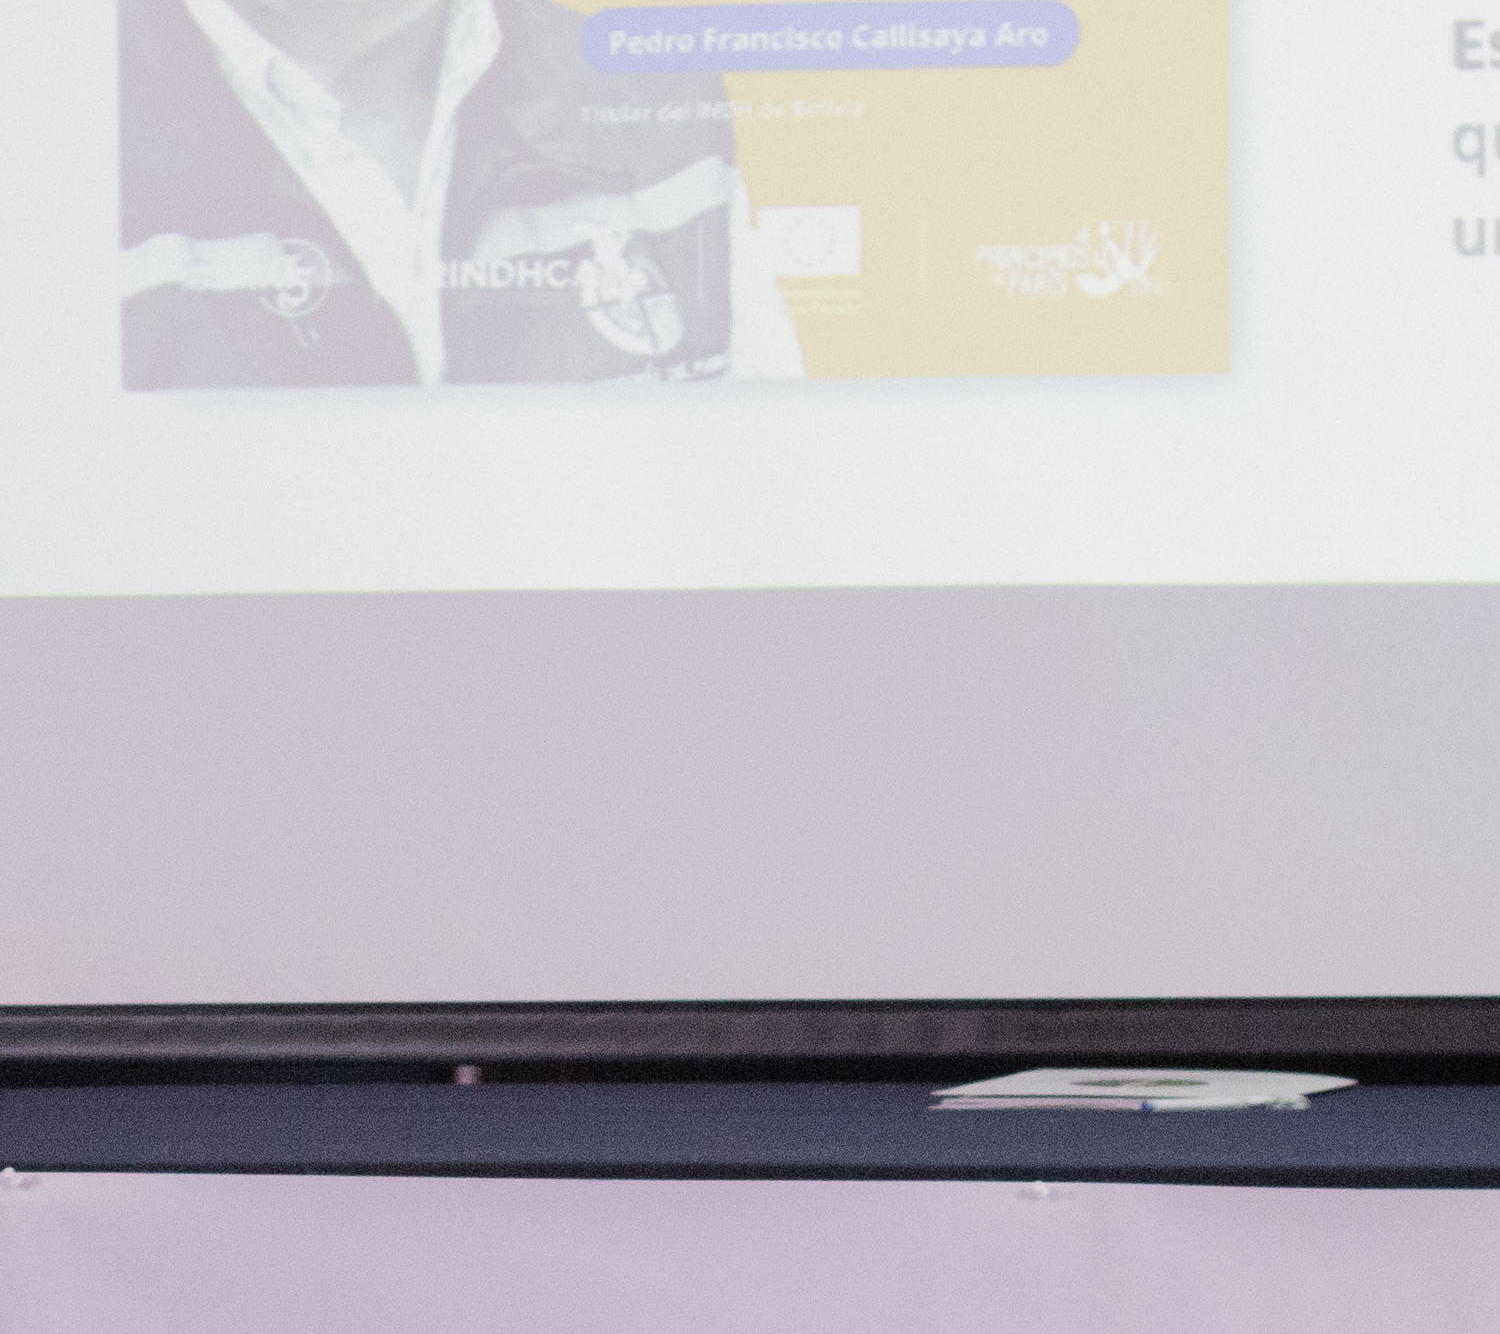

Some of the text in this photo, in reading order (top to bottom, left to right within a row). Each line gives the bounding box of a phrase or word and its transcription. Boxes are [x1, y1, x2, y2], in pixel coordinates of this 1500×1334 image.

[609, 22, 1048, 54] Pedro Francisco Callisaya Aro
